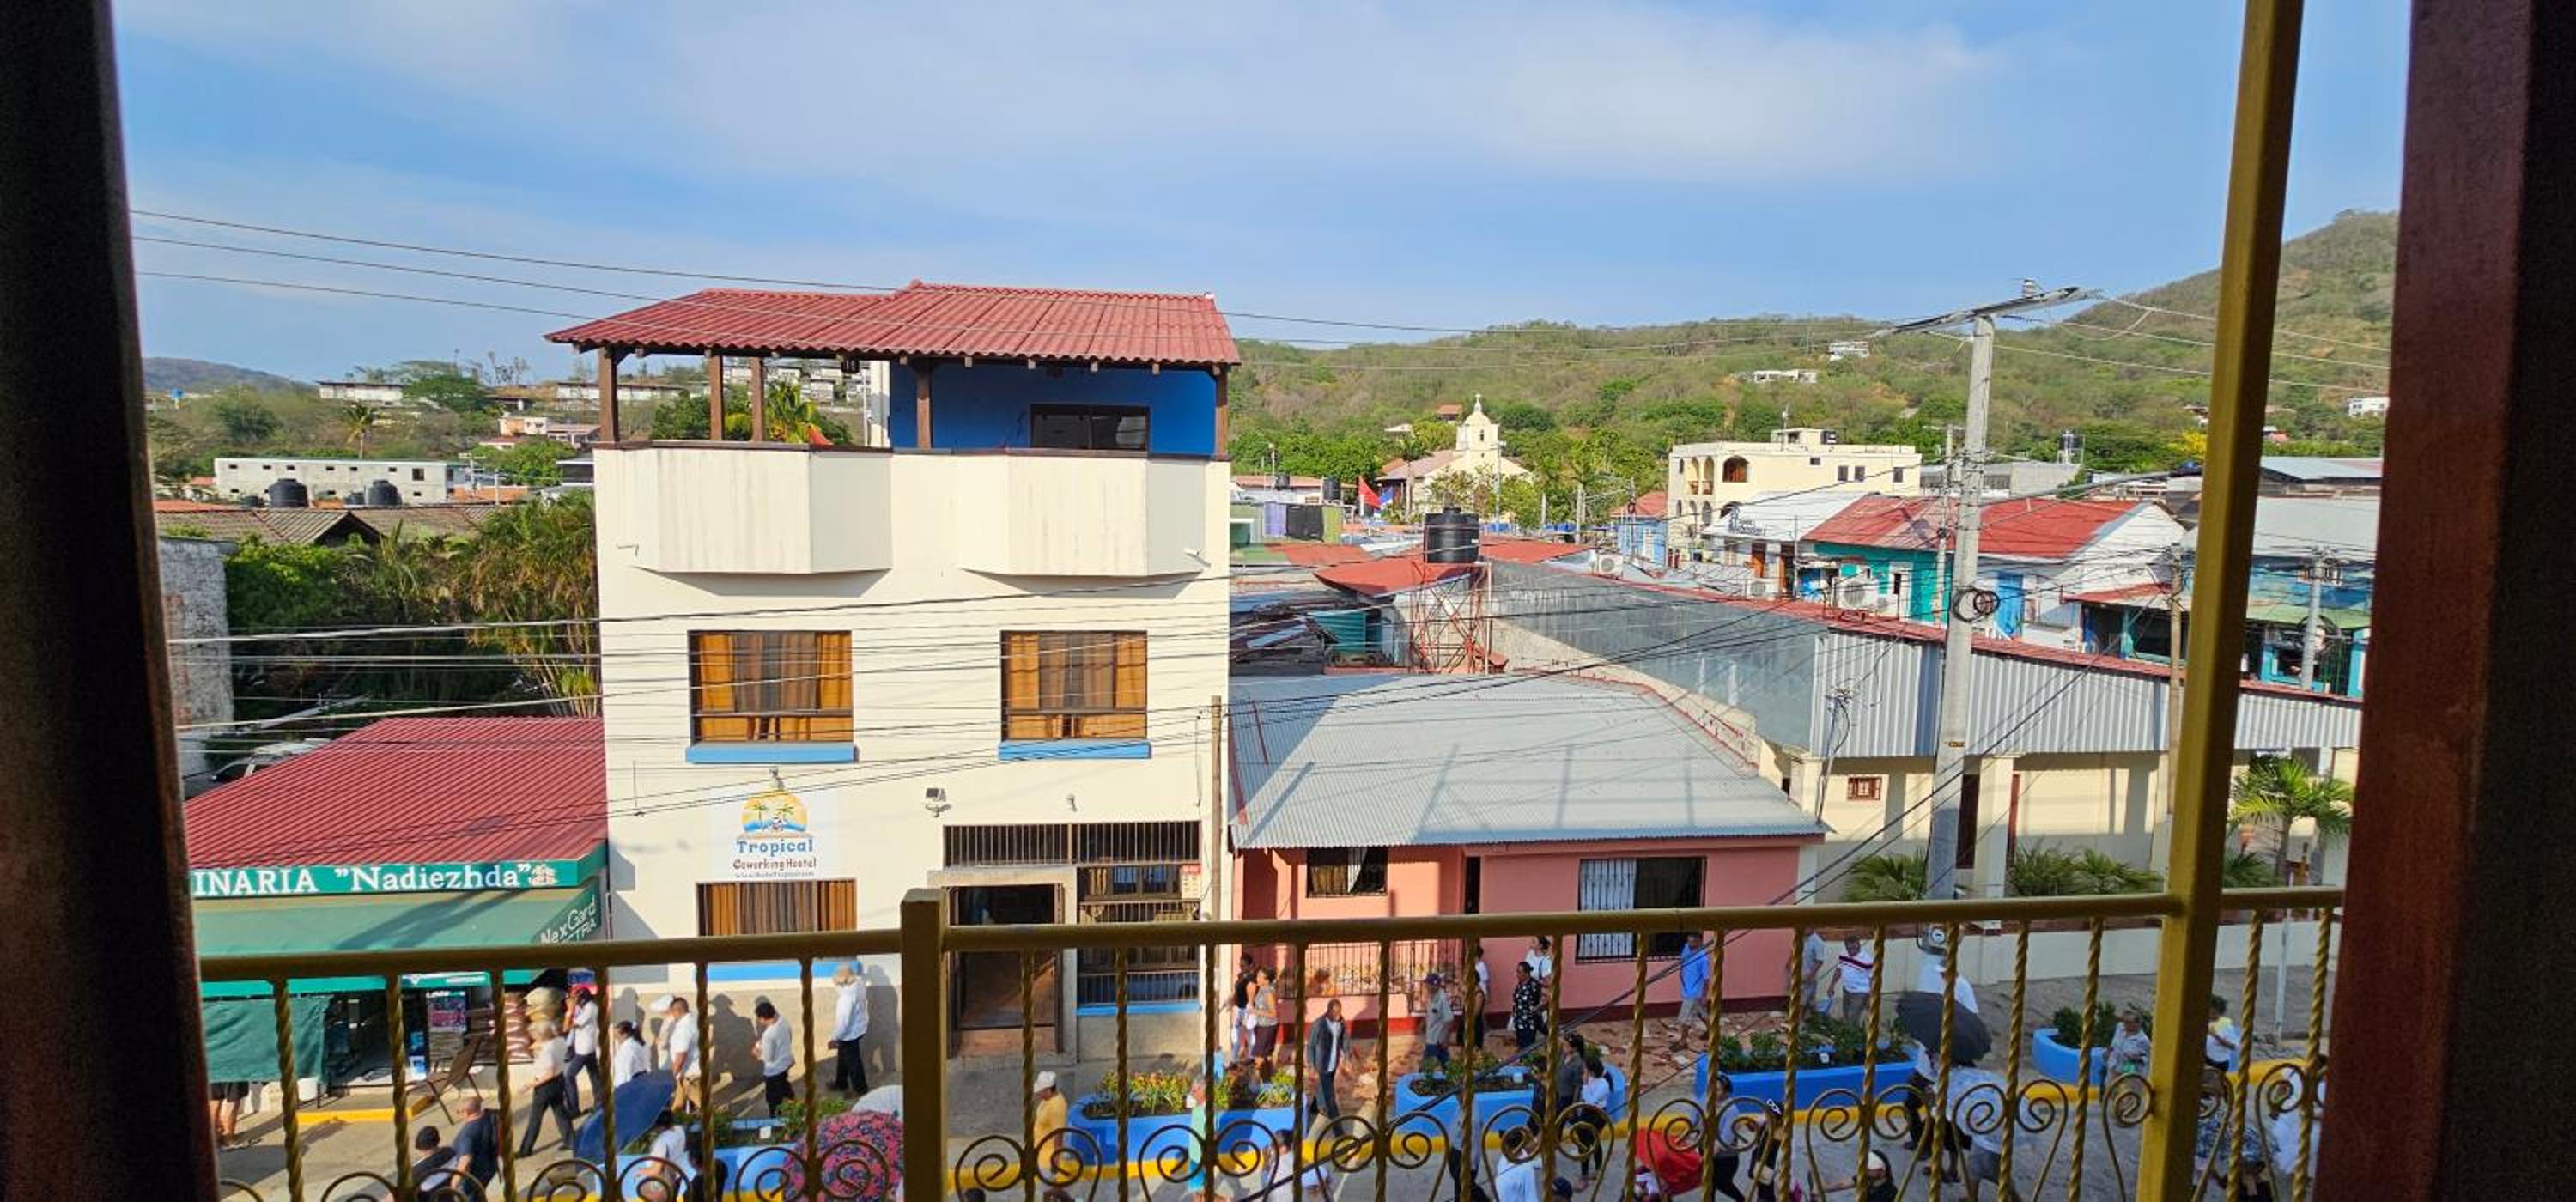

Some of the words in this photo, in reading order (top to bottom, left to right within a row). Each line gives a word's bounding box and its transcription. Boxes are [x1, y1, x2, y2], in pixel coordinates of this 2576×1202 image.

[736, 838, 814, 857] Tropical
[195, 868, 319, 896] INARIA
[334, 863, 532, 891] "Nadiezhda"
